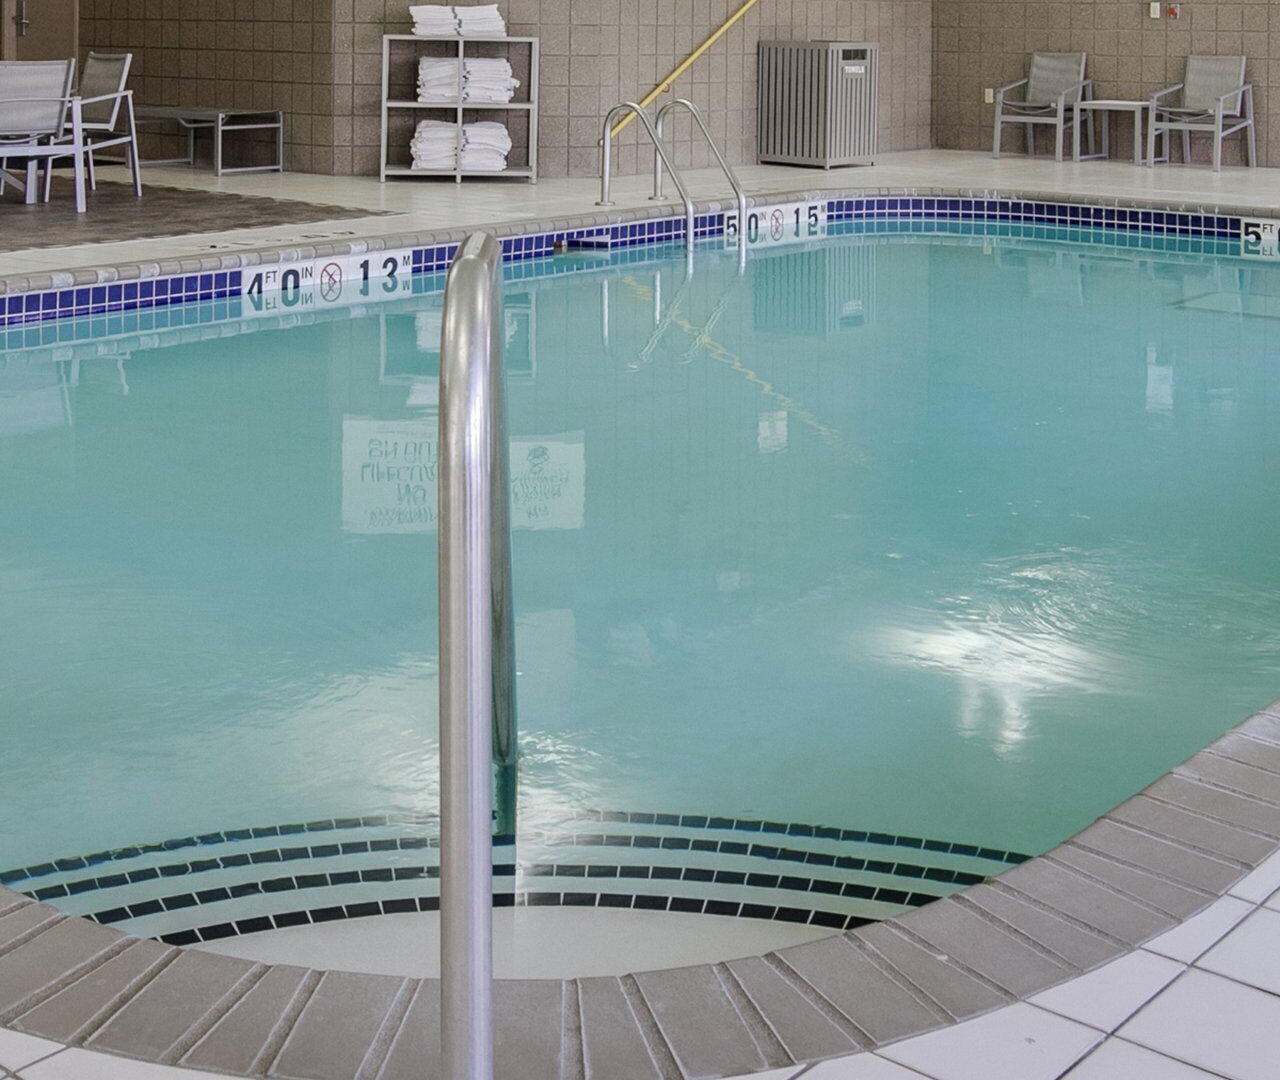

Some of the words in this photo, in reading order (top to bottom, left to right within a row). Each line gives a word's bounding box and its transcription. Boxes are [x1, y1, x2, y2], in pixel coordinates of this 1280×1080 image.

[1262, 224, 1274, 234] FT
[265, 270, 278, 283] FT
[301, 266, 313, 279] IN
[402, 255, 410, 265] M
